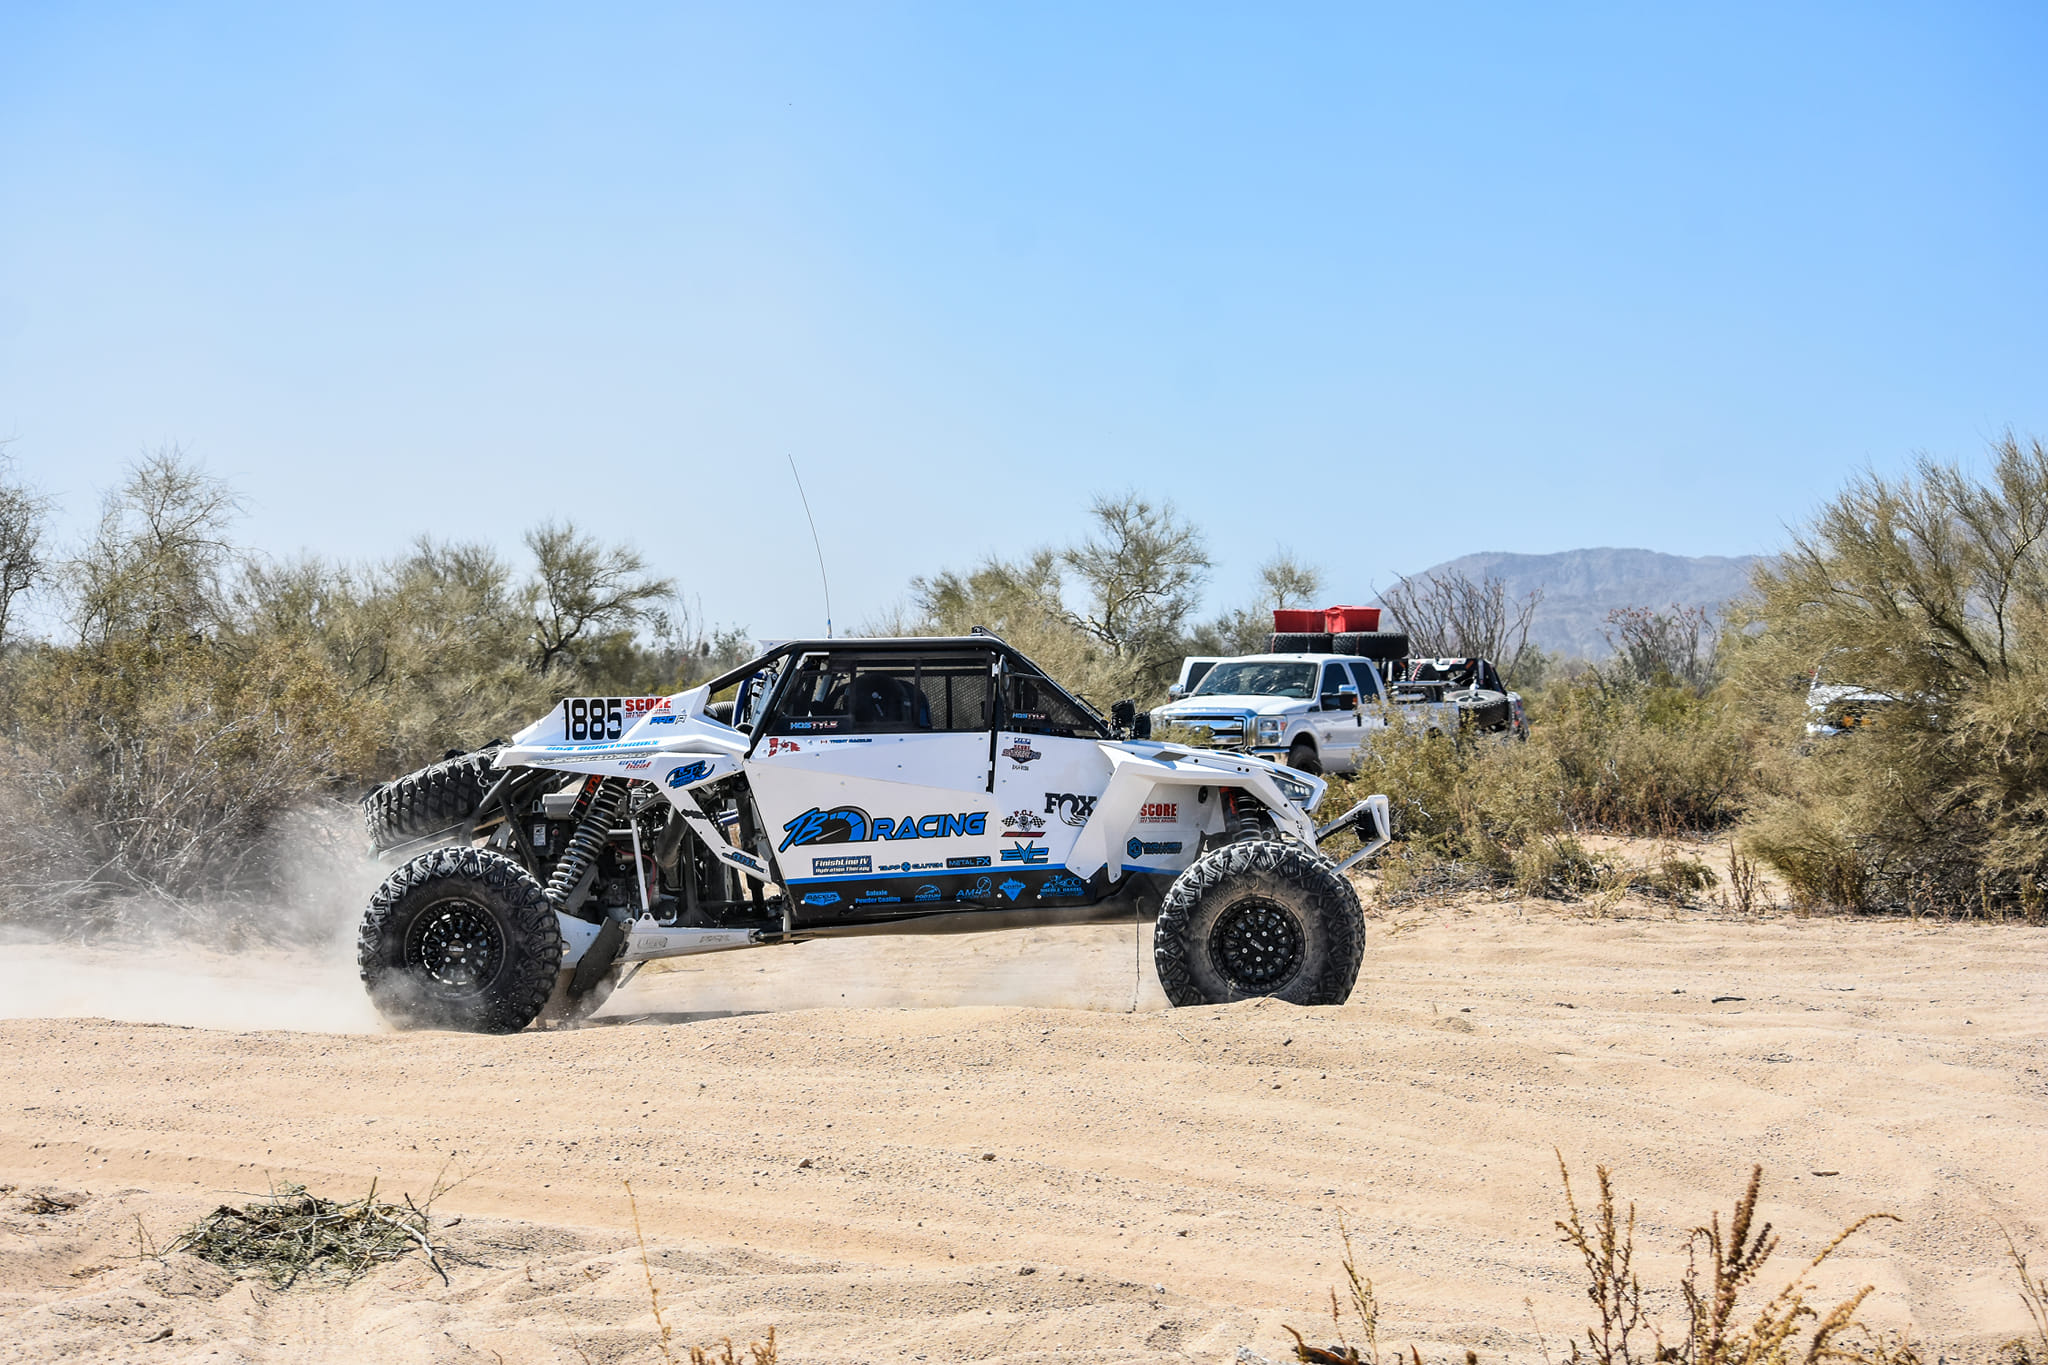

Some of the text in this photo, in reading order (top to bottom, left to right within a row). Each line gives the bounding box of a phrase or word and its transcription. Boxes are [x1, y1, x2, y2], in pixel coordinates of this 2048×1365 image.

[564, 698, 622, 741] 1885
[1044, 792, 1097, 825] FOX
[1140, 803, 1177, 816] SCORE
[778, 808, 989, 852] TB RACING
[815, 865, 870, 874] Hydration Therapy
[976, 857, 990, 865] FX
